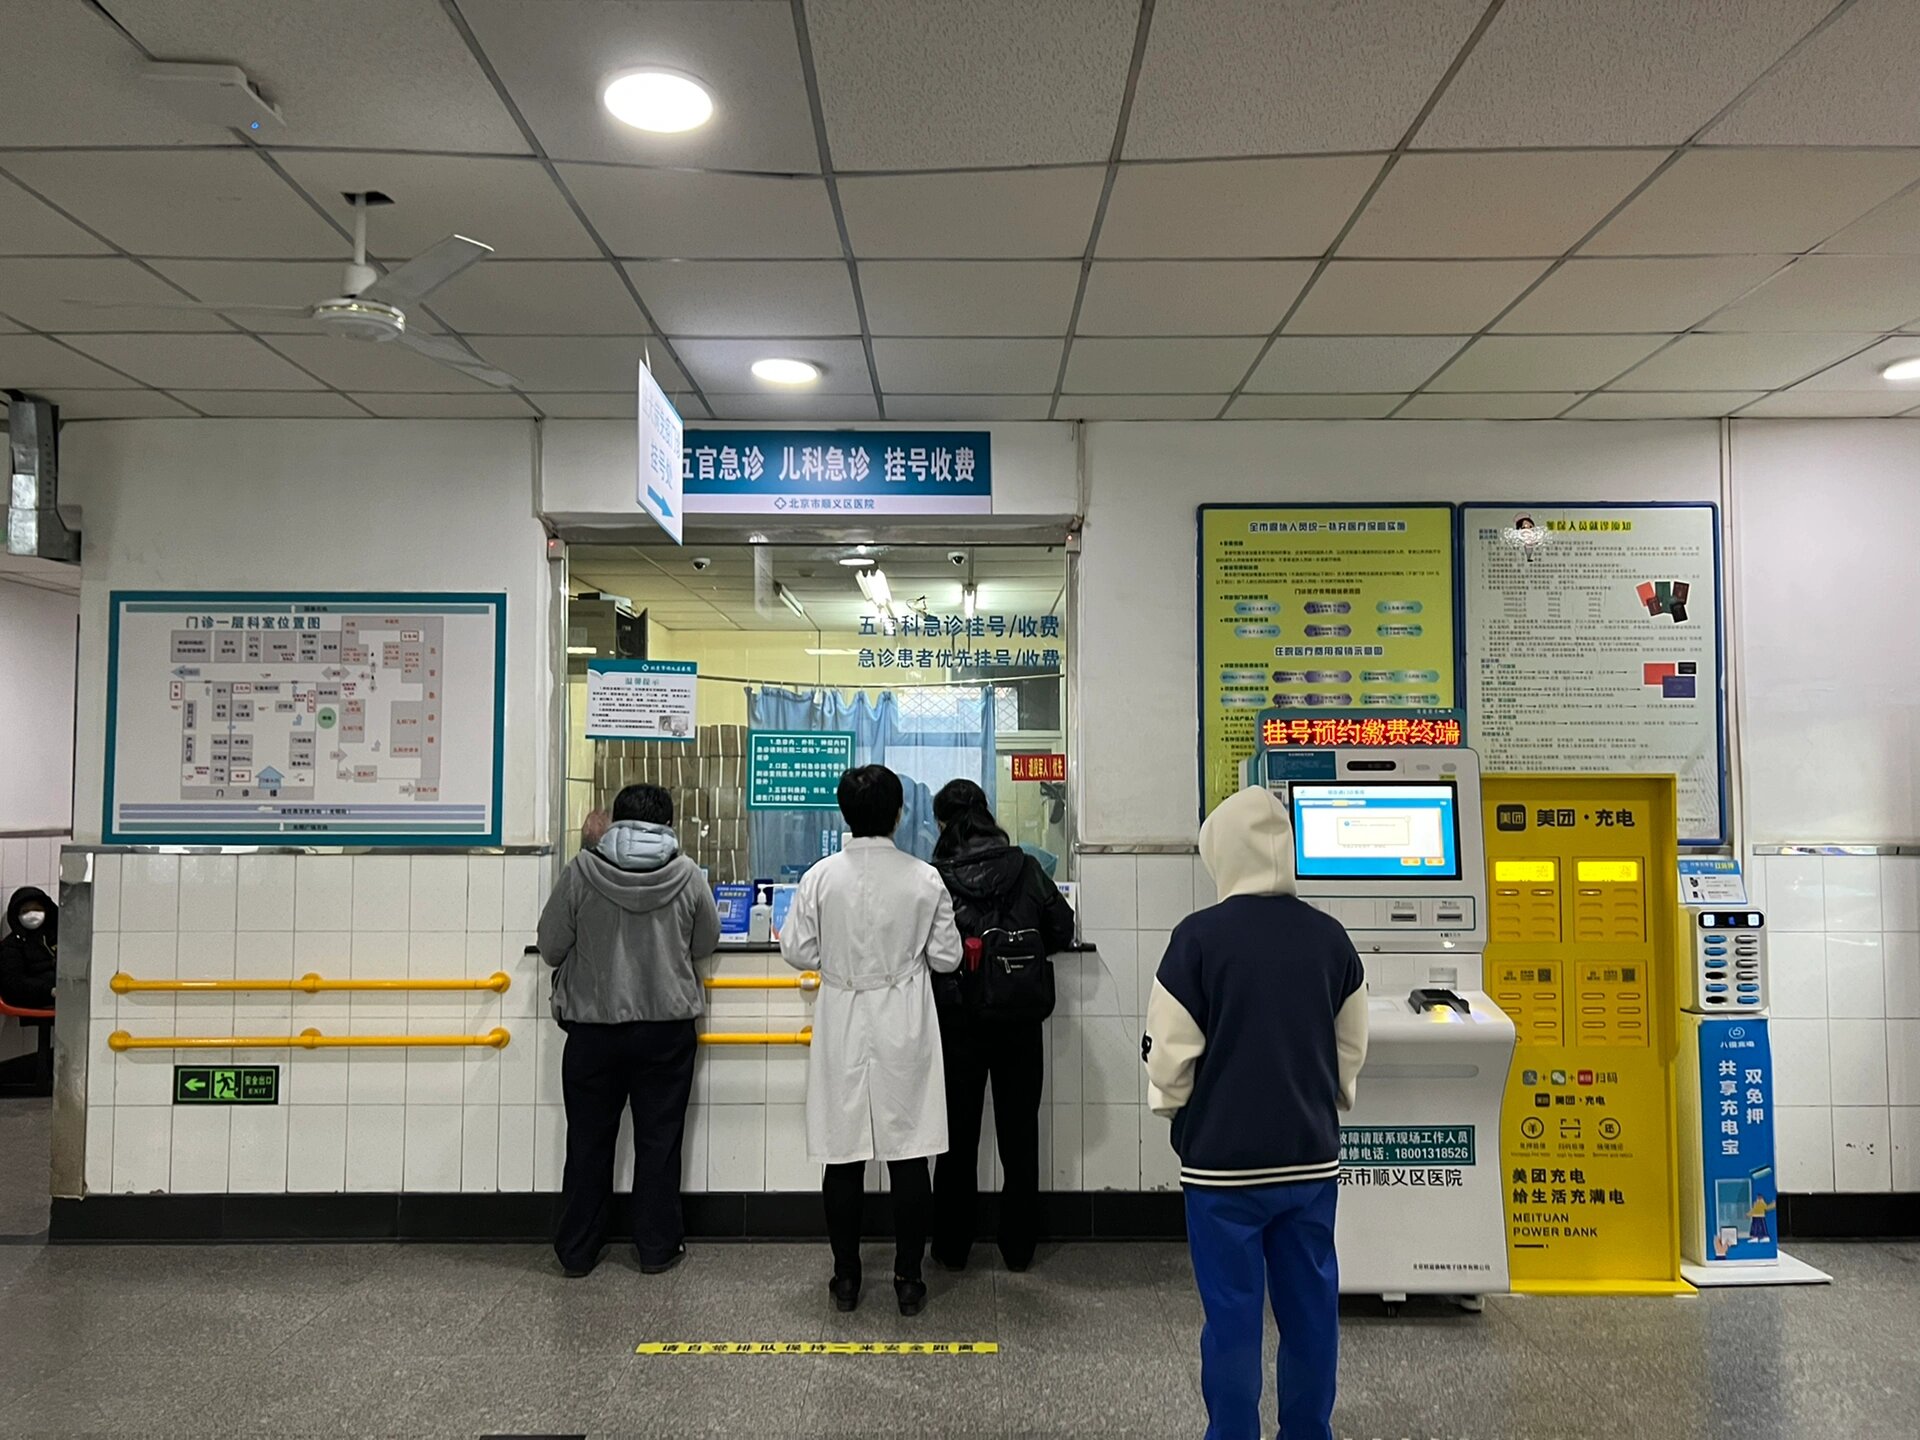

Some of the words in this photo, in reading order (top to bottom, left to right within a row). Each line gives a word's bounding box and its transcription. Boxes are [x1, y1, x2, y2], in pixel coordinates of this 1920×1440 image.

[683, 446, 764, 481] 五官急诊
[779, 447, 870, 482] 儿科急诊
[884, 447, 975, 482] 挂号收费
[789, 497, 875, 509] 北京市顺义区医院
[186, 616, 320, 629] 门诊一层科室位置图
[858, 615, 1060, 638] 五官科急诊挂号/收费
[858, 648, 1060, 668] 急诊患者优先挂号/收费
[1263, 718, 1460, 746] 挂号预约缴费终端
[1014, 758, 1024, 777] 军人
[1028, 758, 1048, 777] 退役军人
[1052, 758, 1063, 777] 优先
[1500, 812, 1523, 824] 美团
[245, 1075, 272, 1086] 安全出口
[1596, 1072, 1618, 1084] 扫码
[248, 1087, 266, 1095] EXIT
[1745, 1069, 1764, 1124] 双免押
[1719, 1060, 1739, 1155] 共享充电宝
[1512, 1168, 1585, 1184] 美团充电
[1512, 1189, 1625, 1204] 给生活充满电
[1513, 1213, 1569, 1223] MEITUAN
[1513, 1227, 1559, 1237] POWER
[1564, 1227, 1598, 1237] BANK
